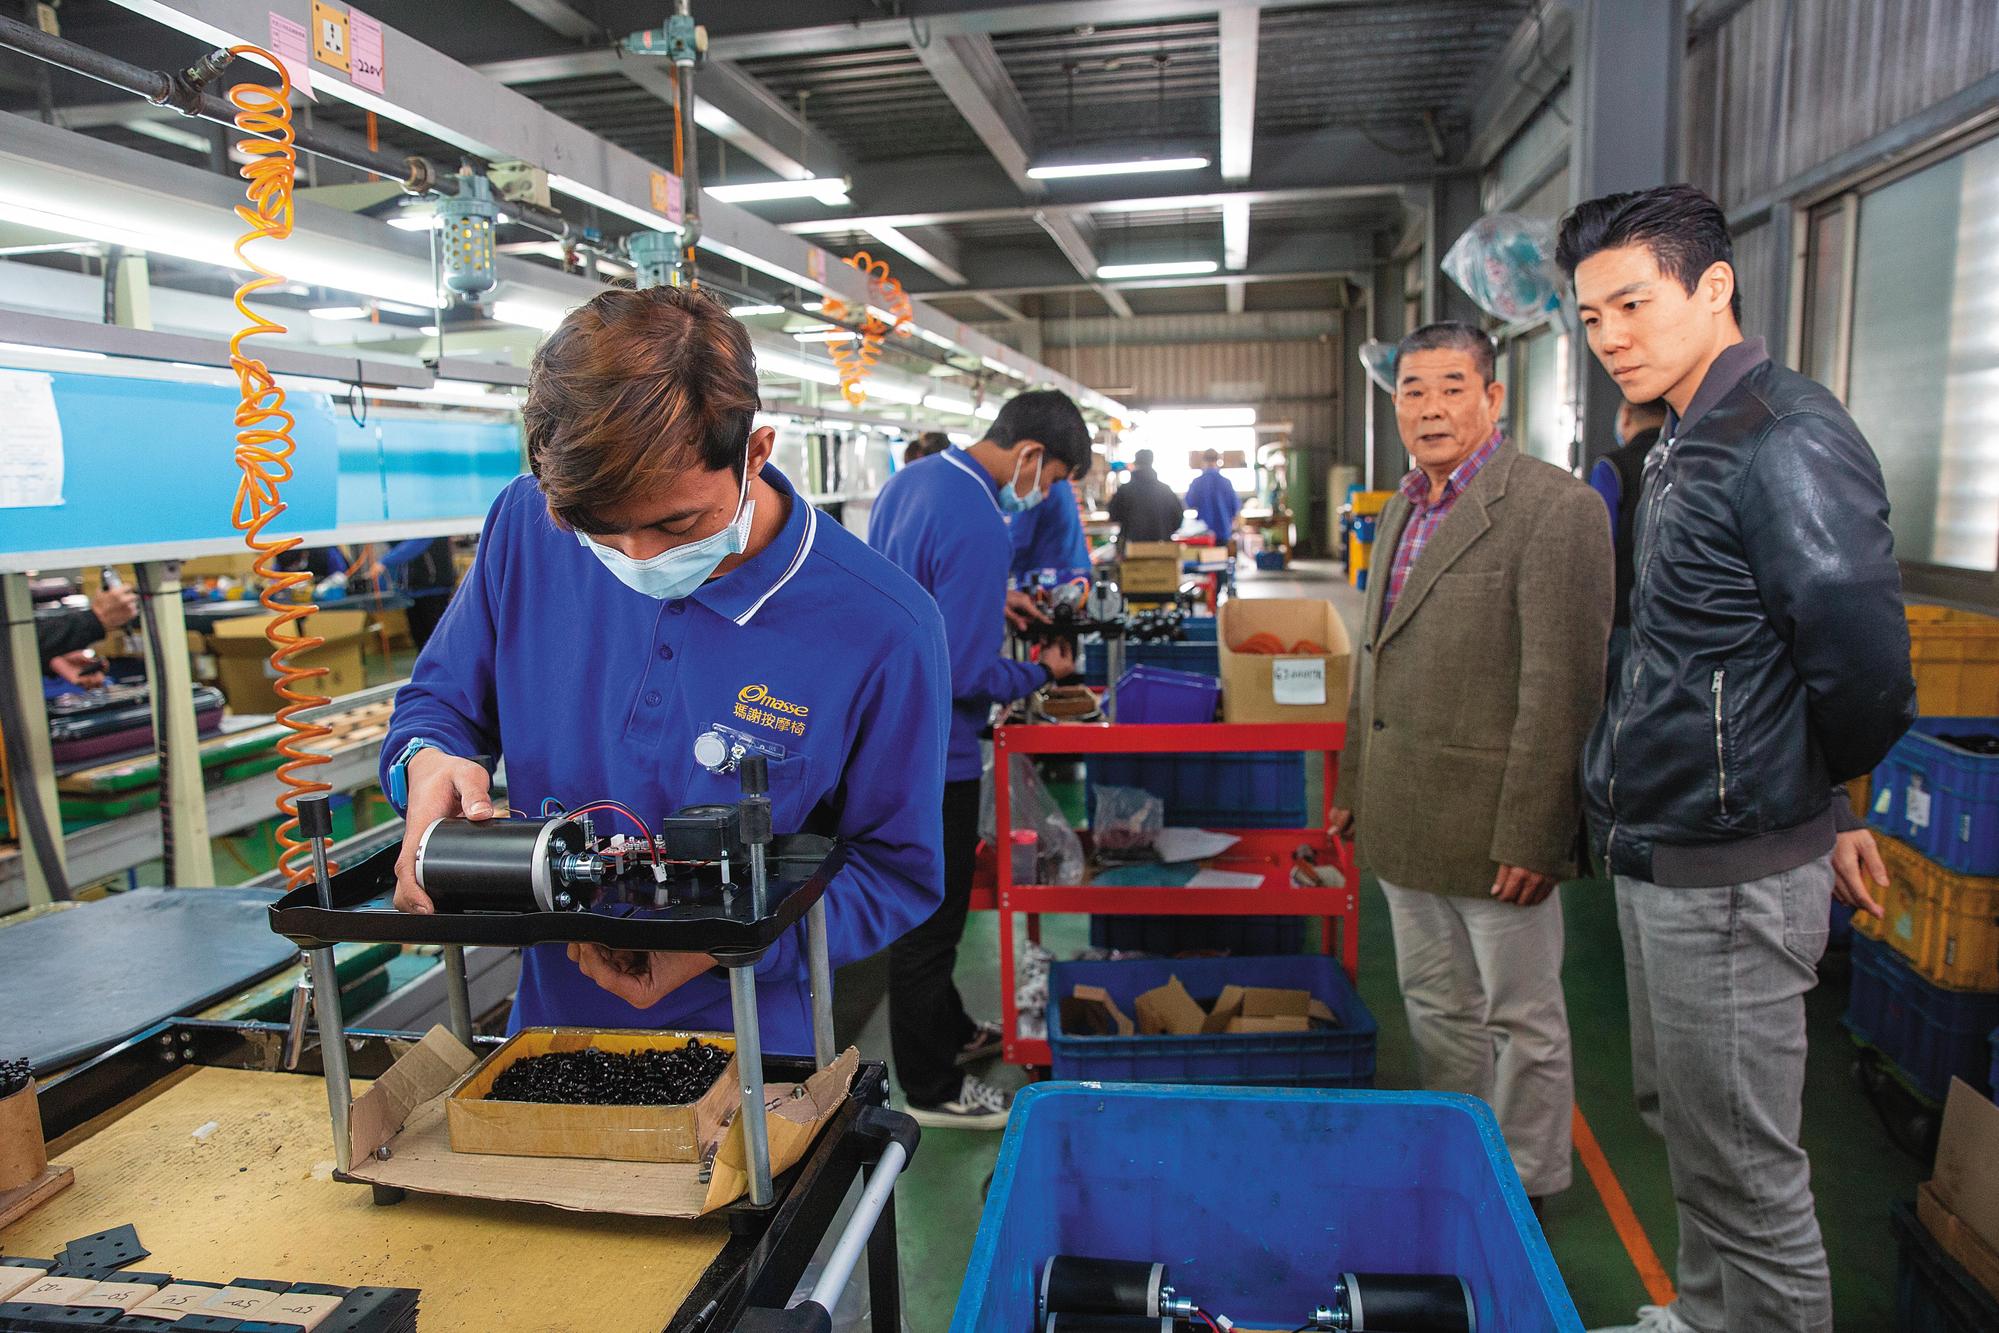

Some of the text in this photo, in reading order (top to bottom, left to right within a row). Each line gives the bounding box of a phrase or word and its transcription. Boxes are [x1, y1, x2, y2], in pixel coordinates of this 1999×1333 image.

[733, 702, 806, 736] 瑪謝按摩椅
